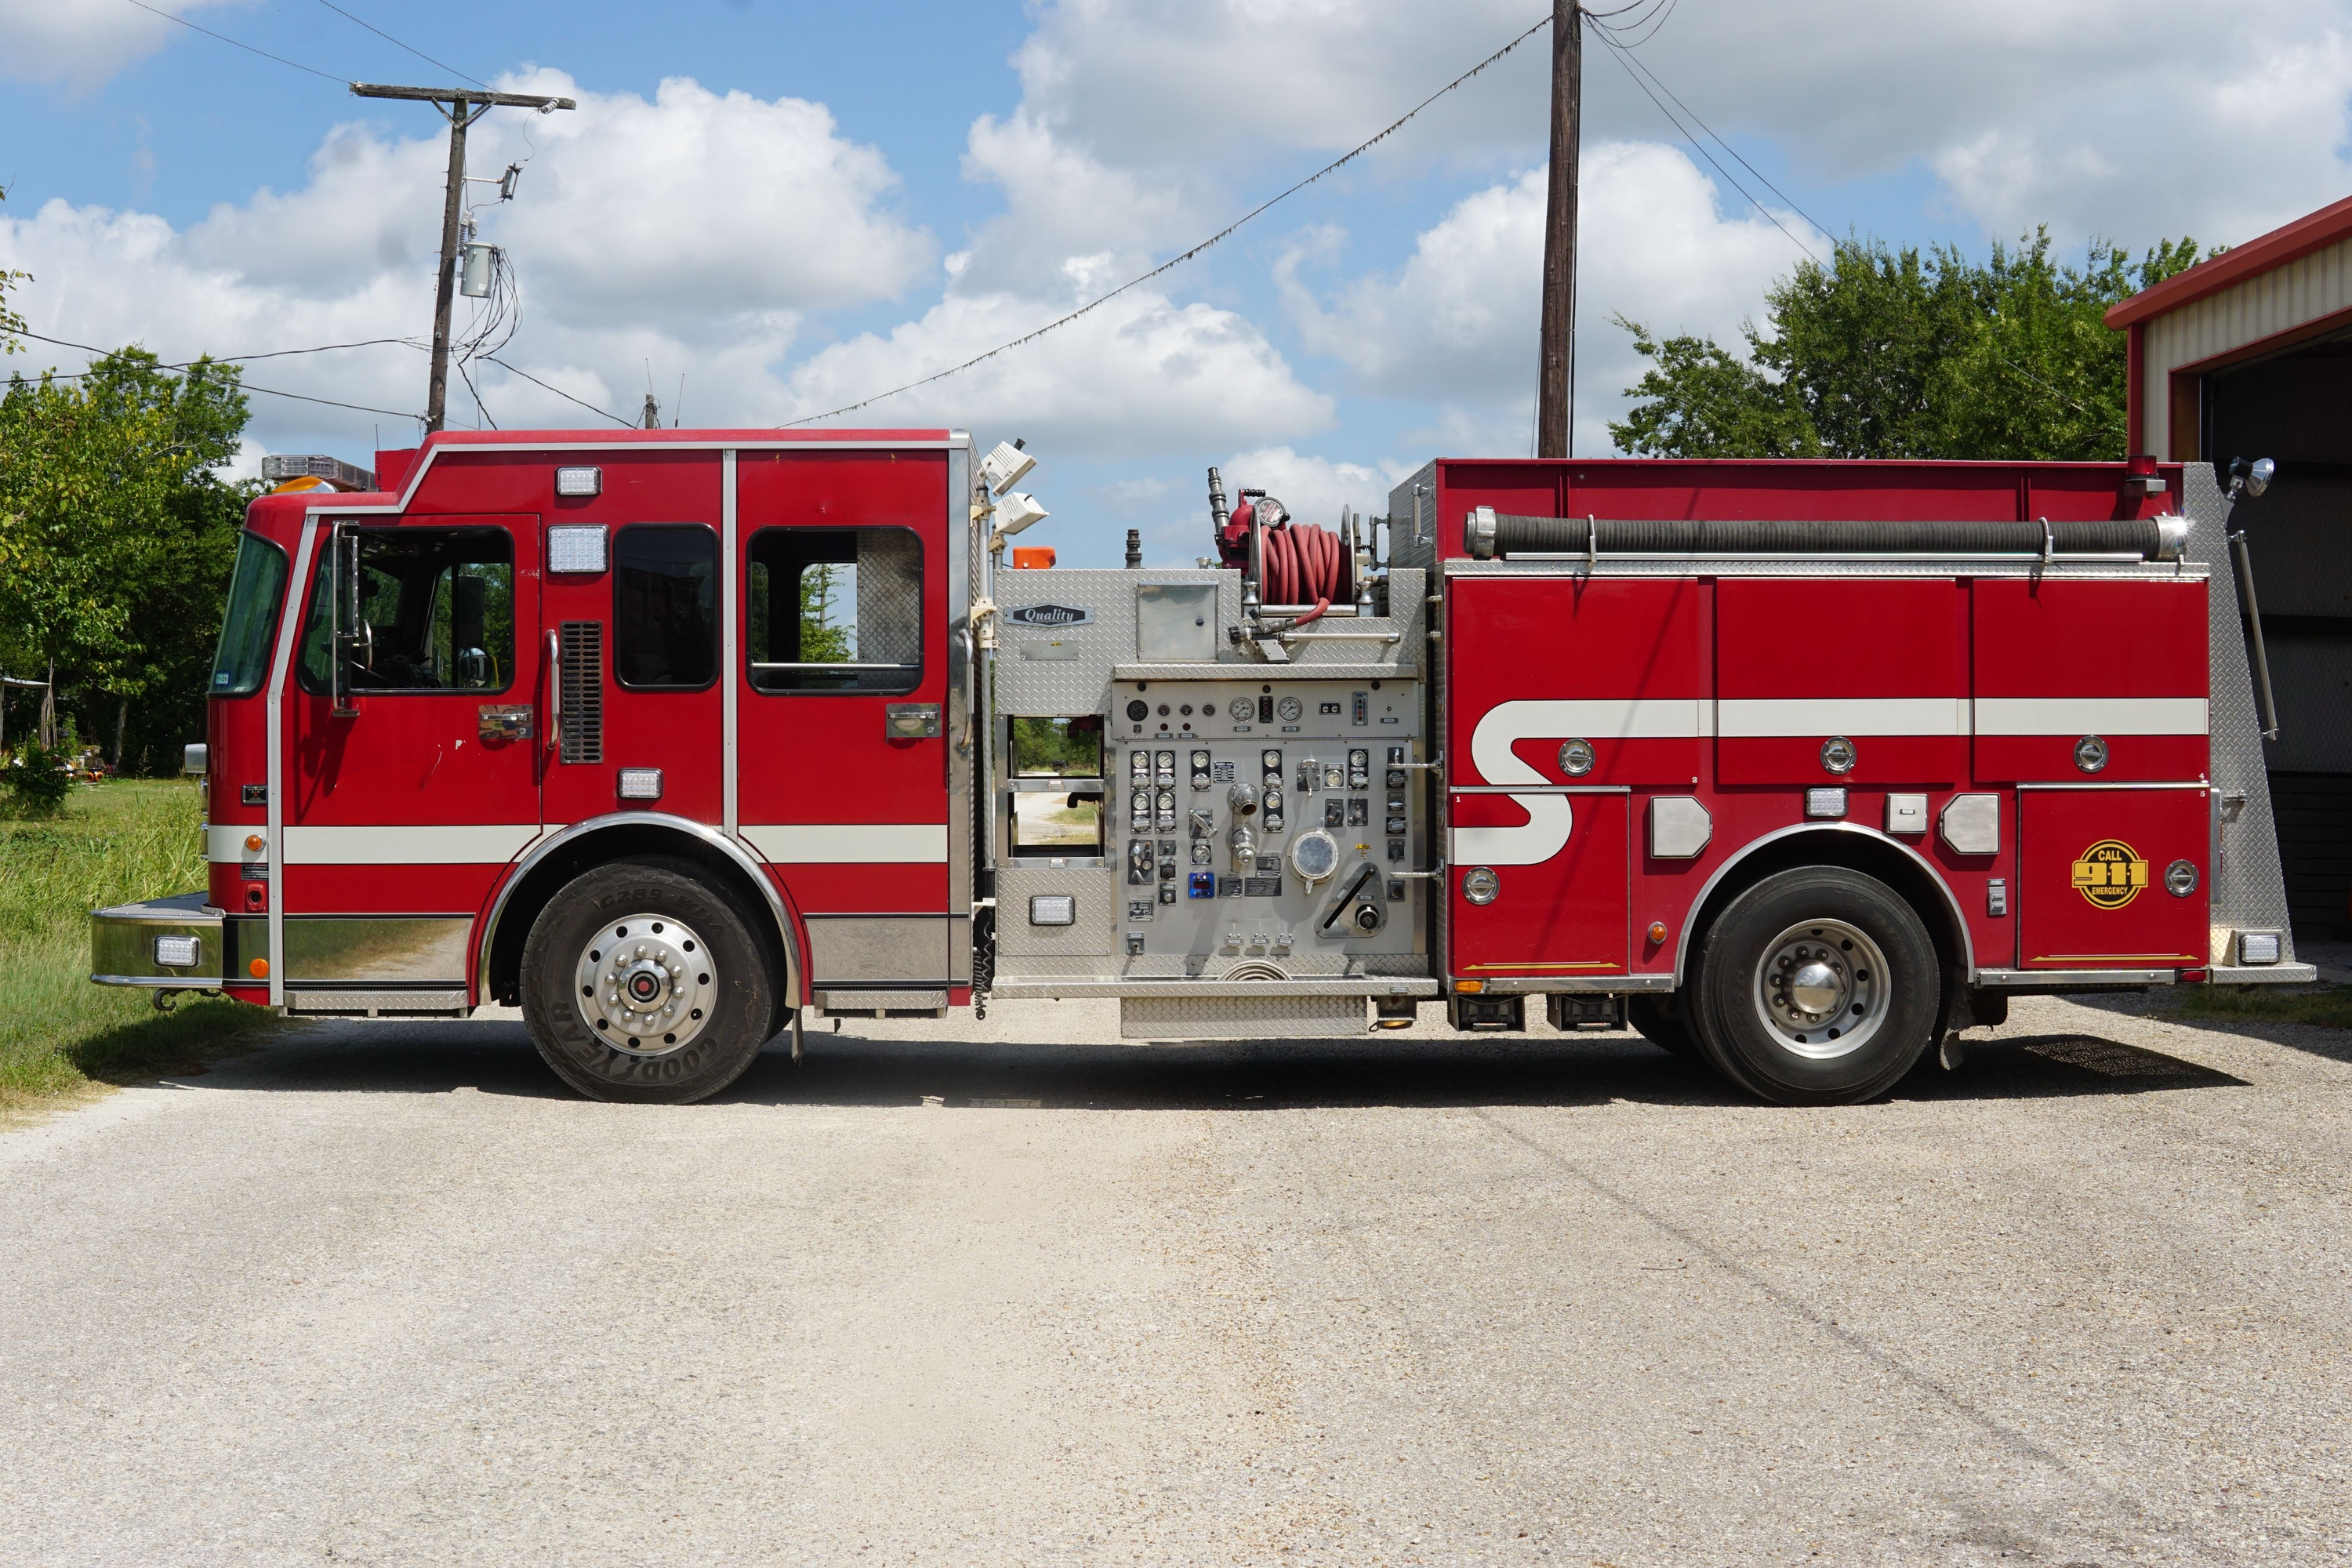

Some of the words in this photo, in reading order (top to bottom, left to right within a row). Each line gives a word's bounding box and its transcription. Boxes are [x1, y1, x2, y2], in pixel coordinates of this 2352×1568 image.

[1024, 608, 1074, 622] Quality
[2098, 851, 2122, 861] CALL
[600, 888, 663, 909] G289
[675, 895, 726, 938] WHA
[552, 1001, 718, 1080] GOODYEAR
